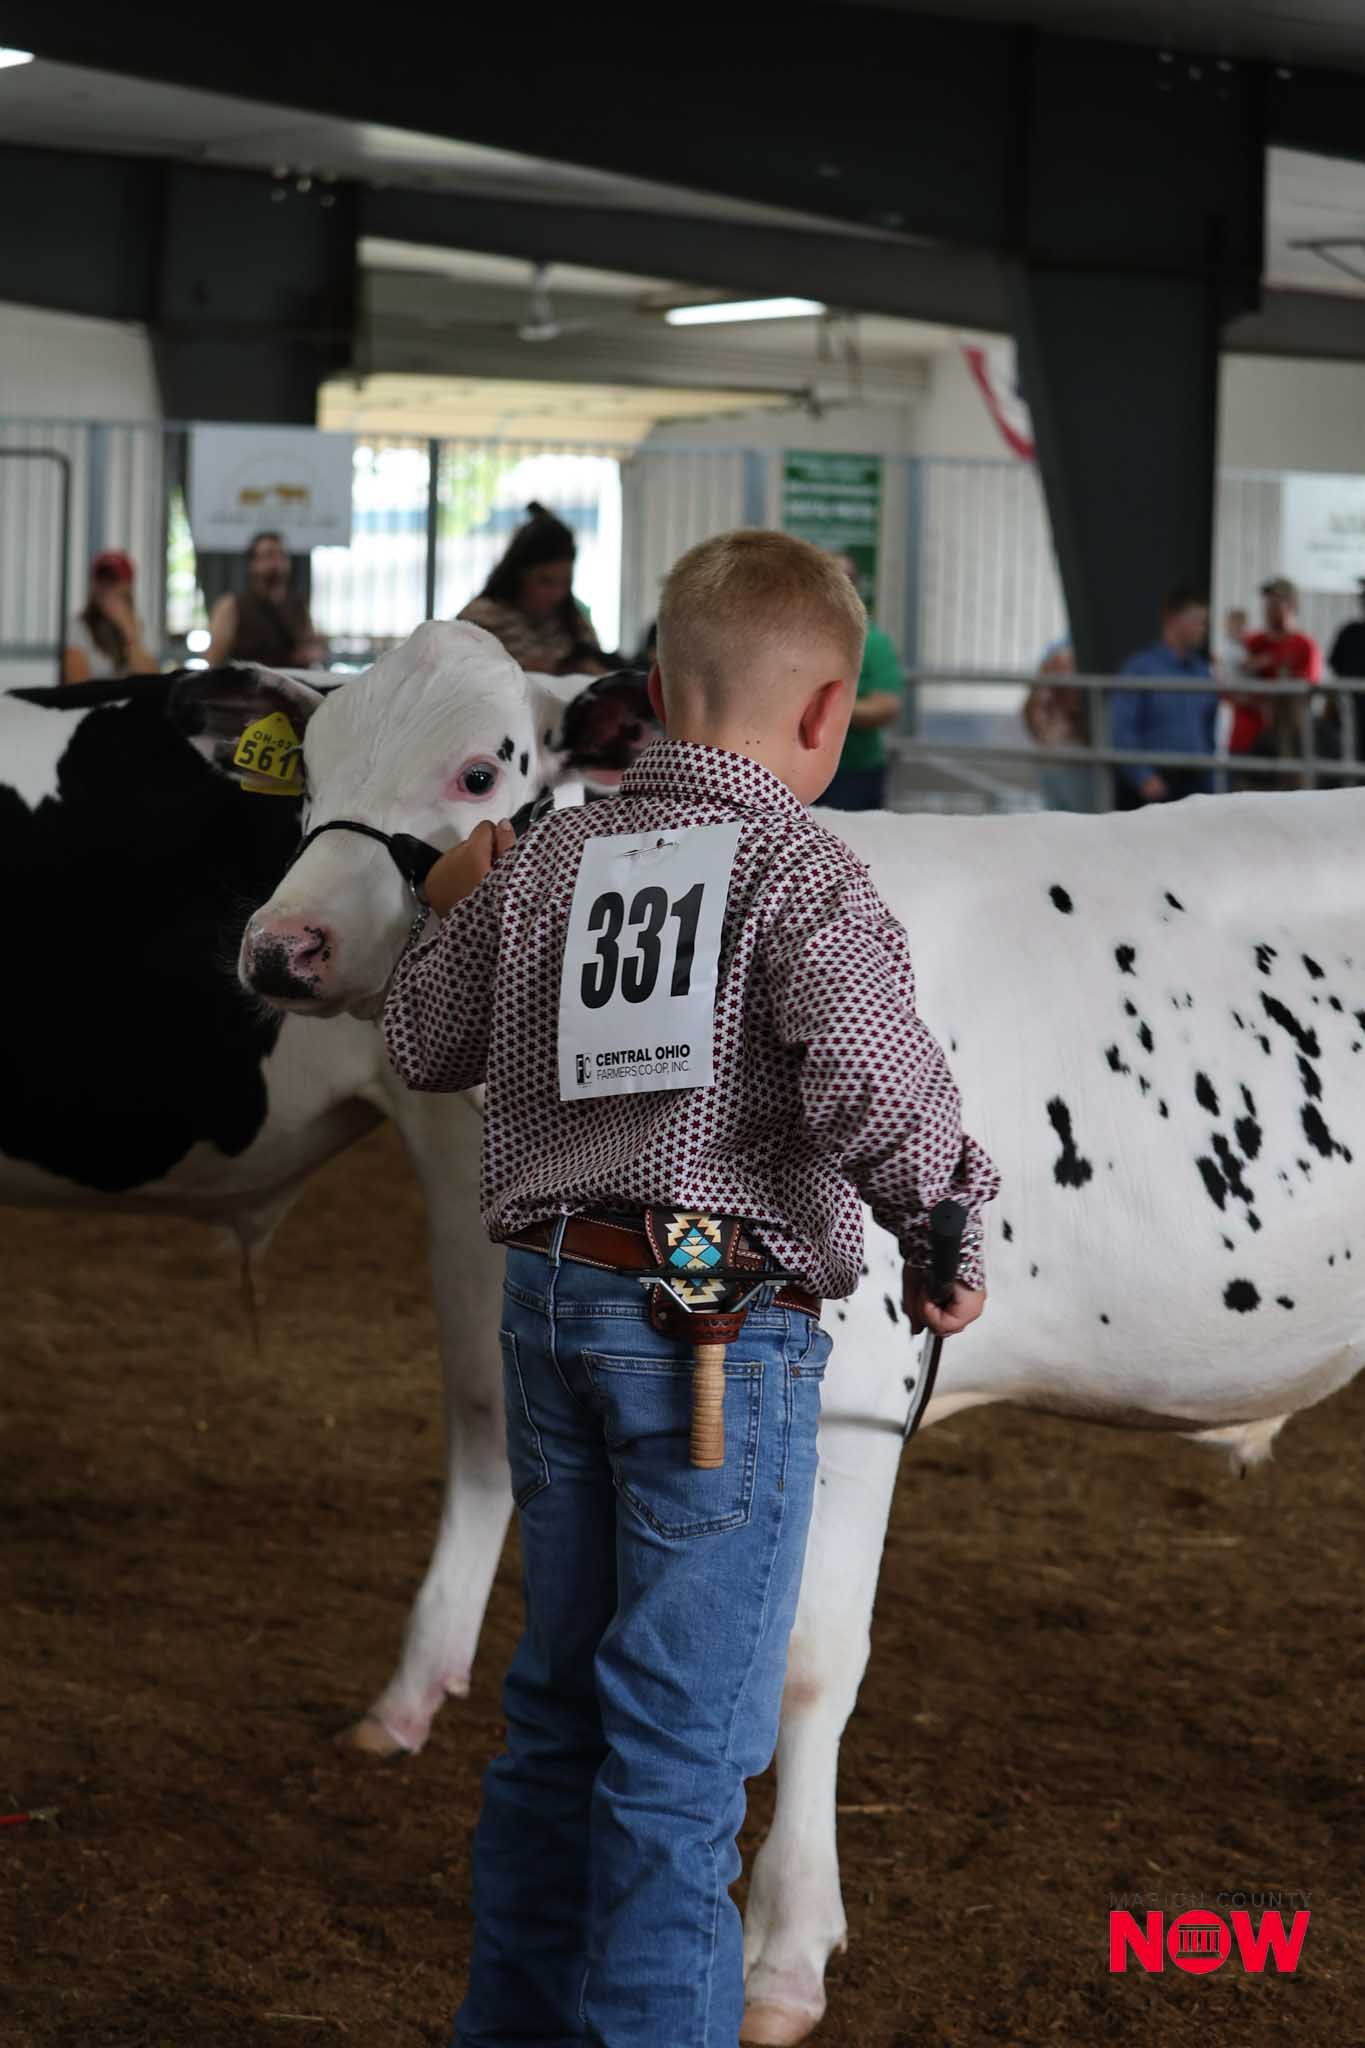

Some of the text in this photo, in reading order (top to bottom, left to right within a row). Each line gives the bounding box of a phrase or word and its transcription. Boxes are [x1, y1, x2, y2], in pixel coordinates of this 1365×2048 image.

[580, 883, 705, 1009] 331
[596, 1044, 690, 1067] CENTRAL OHIO
[597, 1065, 637, 1080] FARMERS
